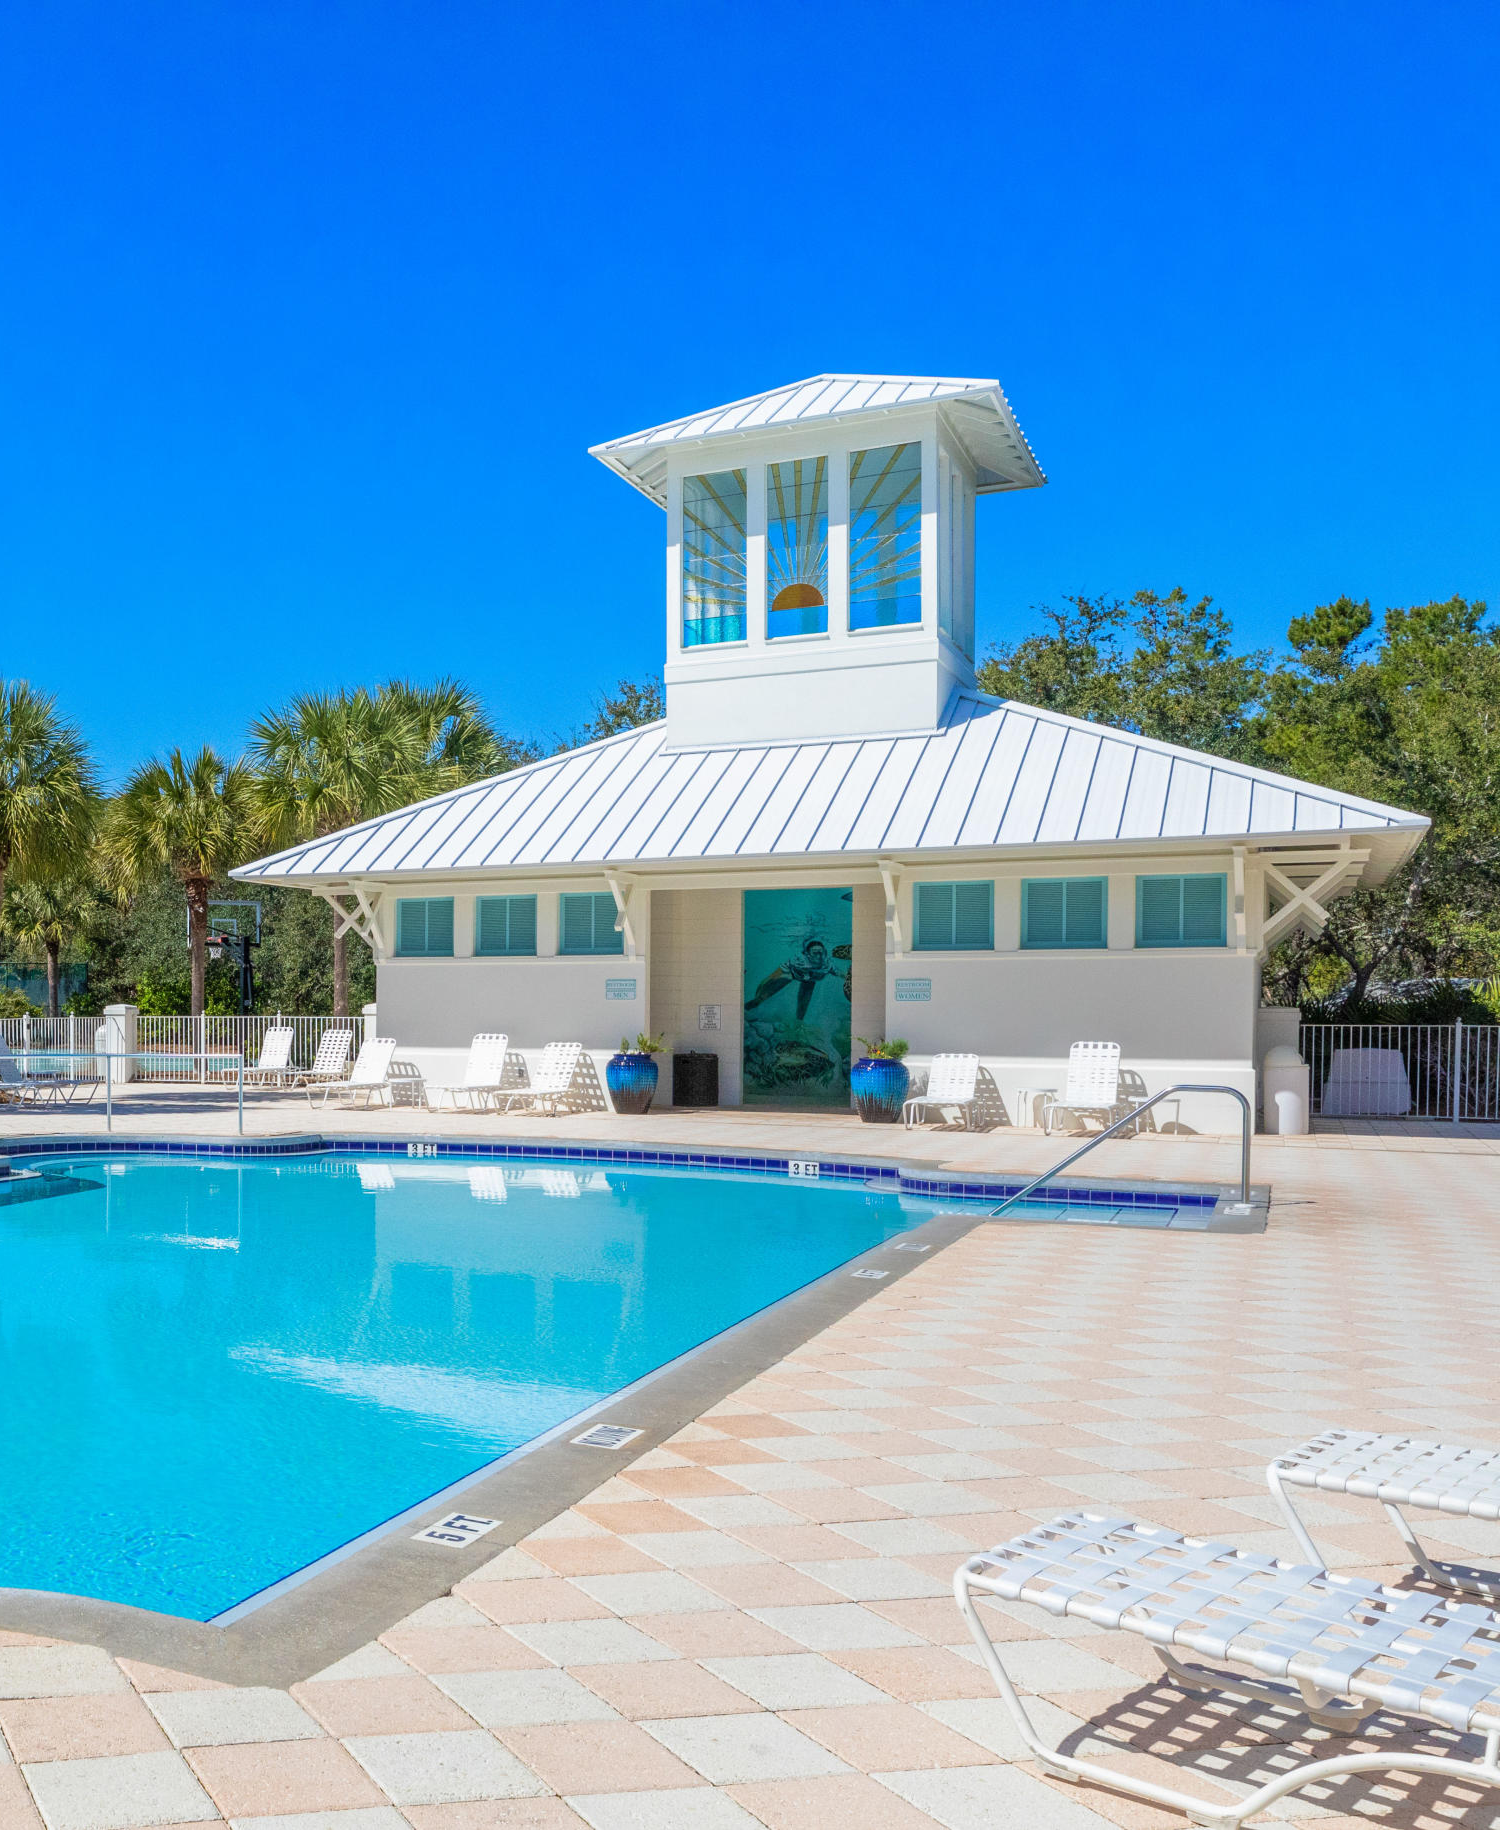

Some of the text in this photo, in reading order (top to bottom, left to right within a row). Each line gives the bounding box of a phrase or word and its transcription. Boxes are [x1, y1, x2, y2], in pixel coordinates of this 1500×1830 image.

[897, 992, 931, 1000] WOMEN
[793, 1163, 800, 1175] 3
[425, 1531, 466, 1542] 5
